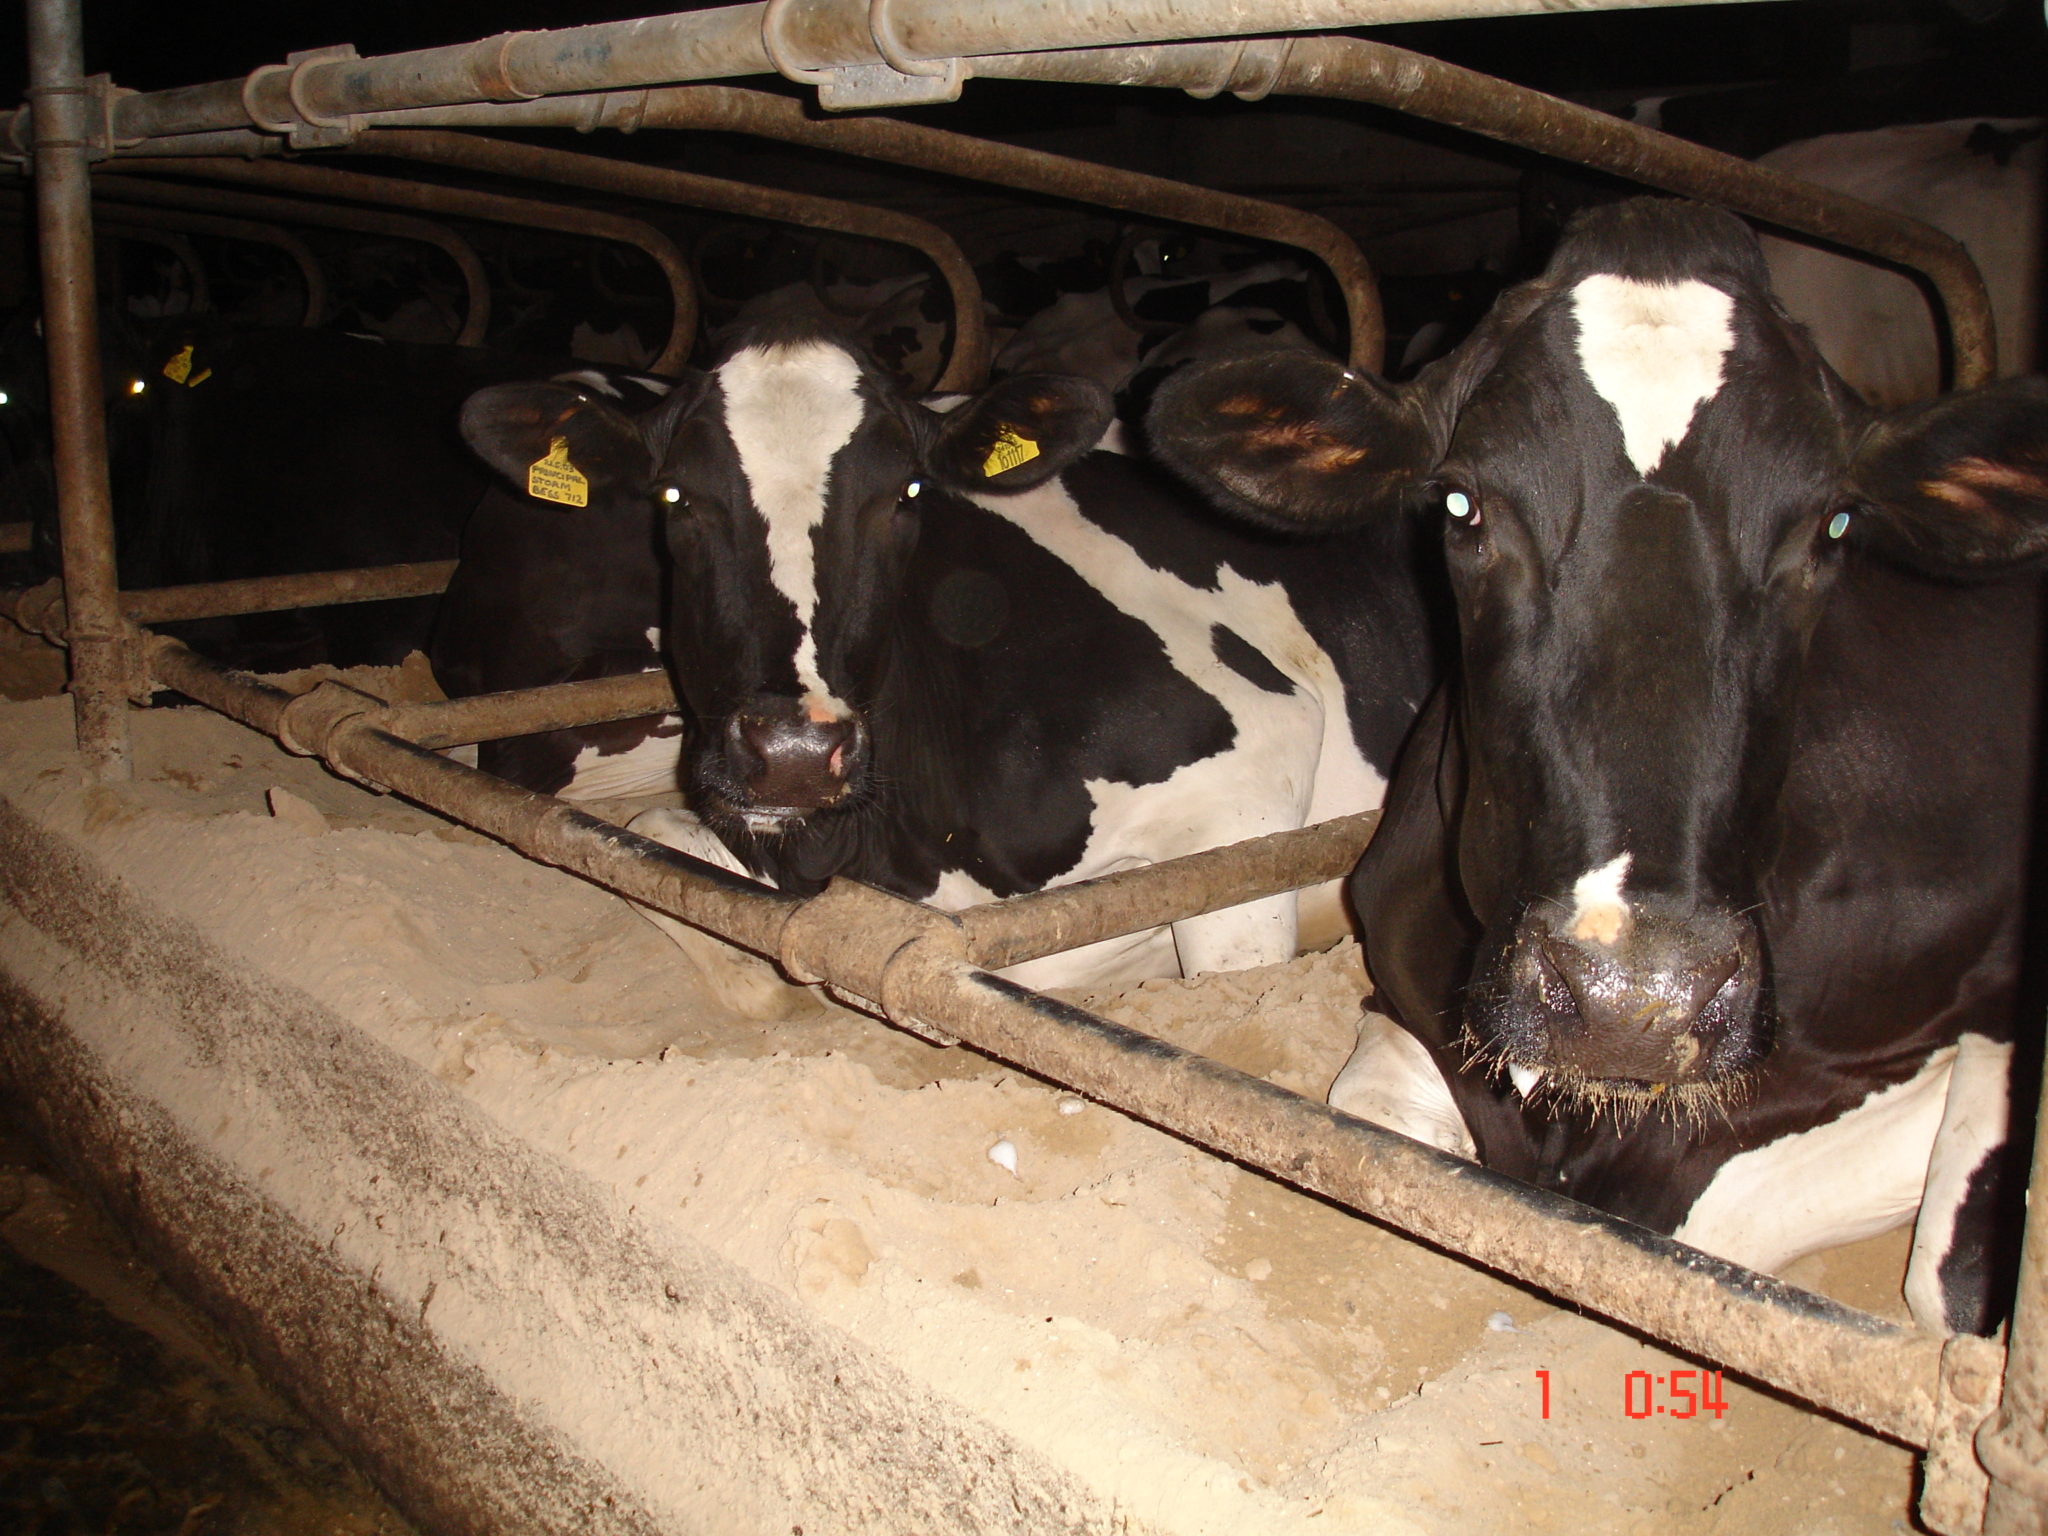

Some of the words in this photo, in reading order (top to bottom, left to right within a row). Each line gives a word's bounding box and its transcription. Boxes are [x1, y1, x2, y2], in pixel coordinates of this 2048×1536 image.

[532, 466, 585, 485] PRINCIPAL
[532, 477, 571, 491] STORM
[565, 493, 584, 504] 712
